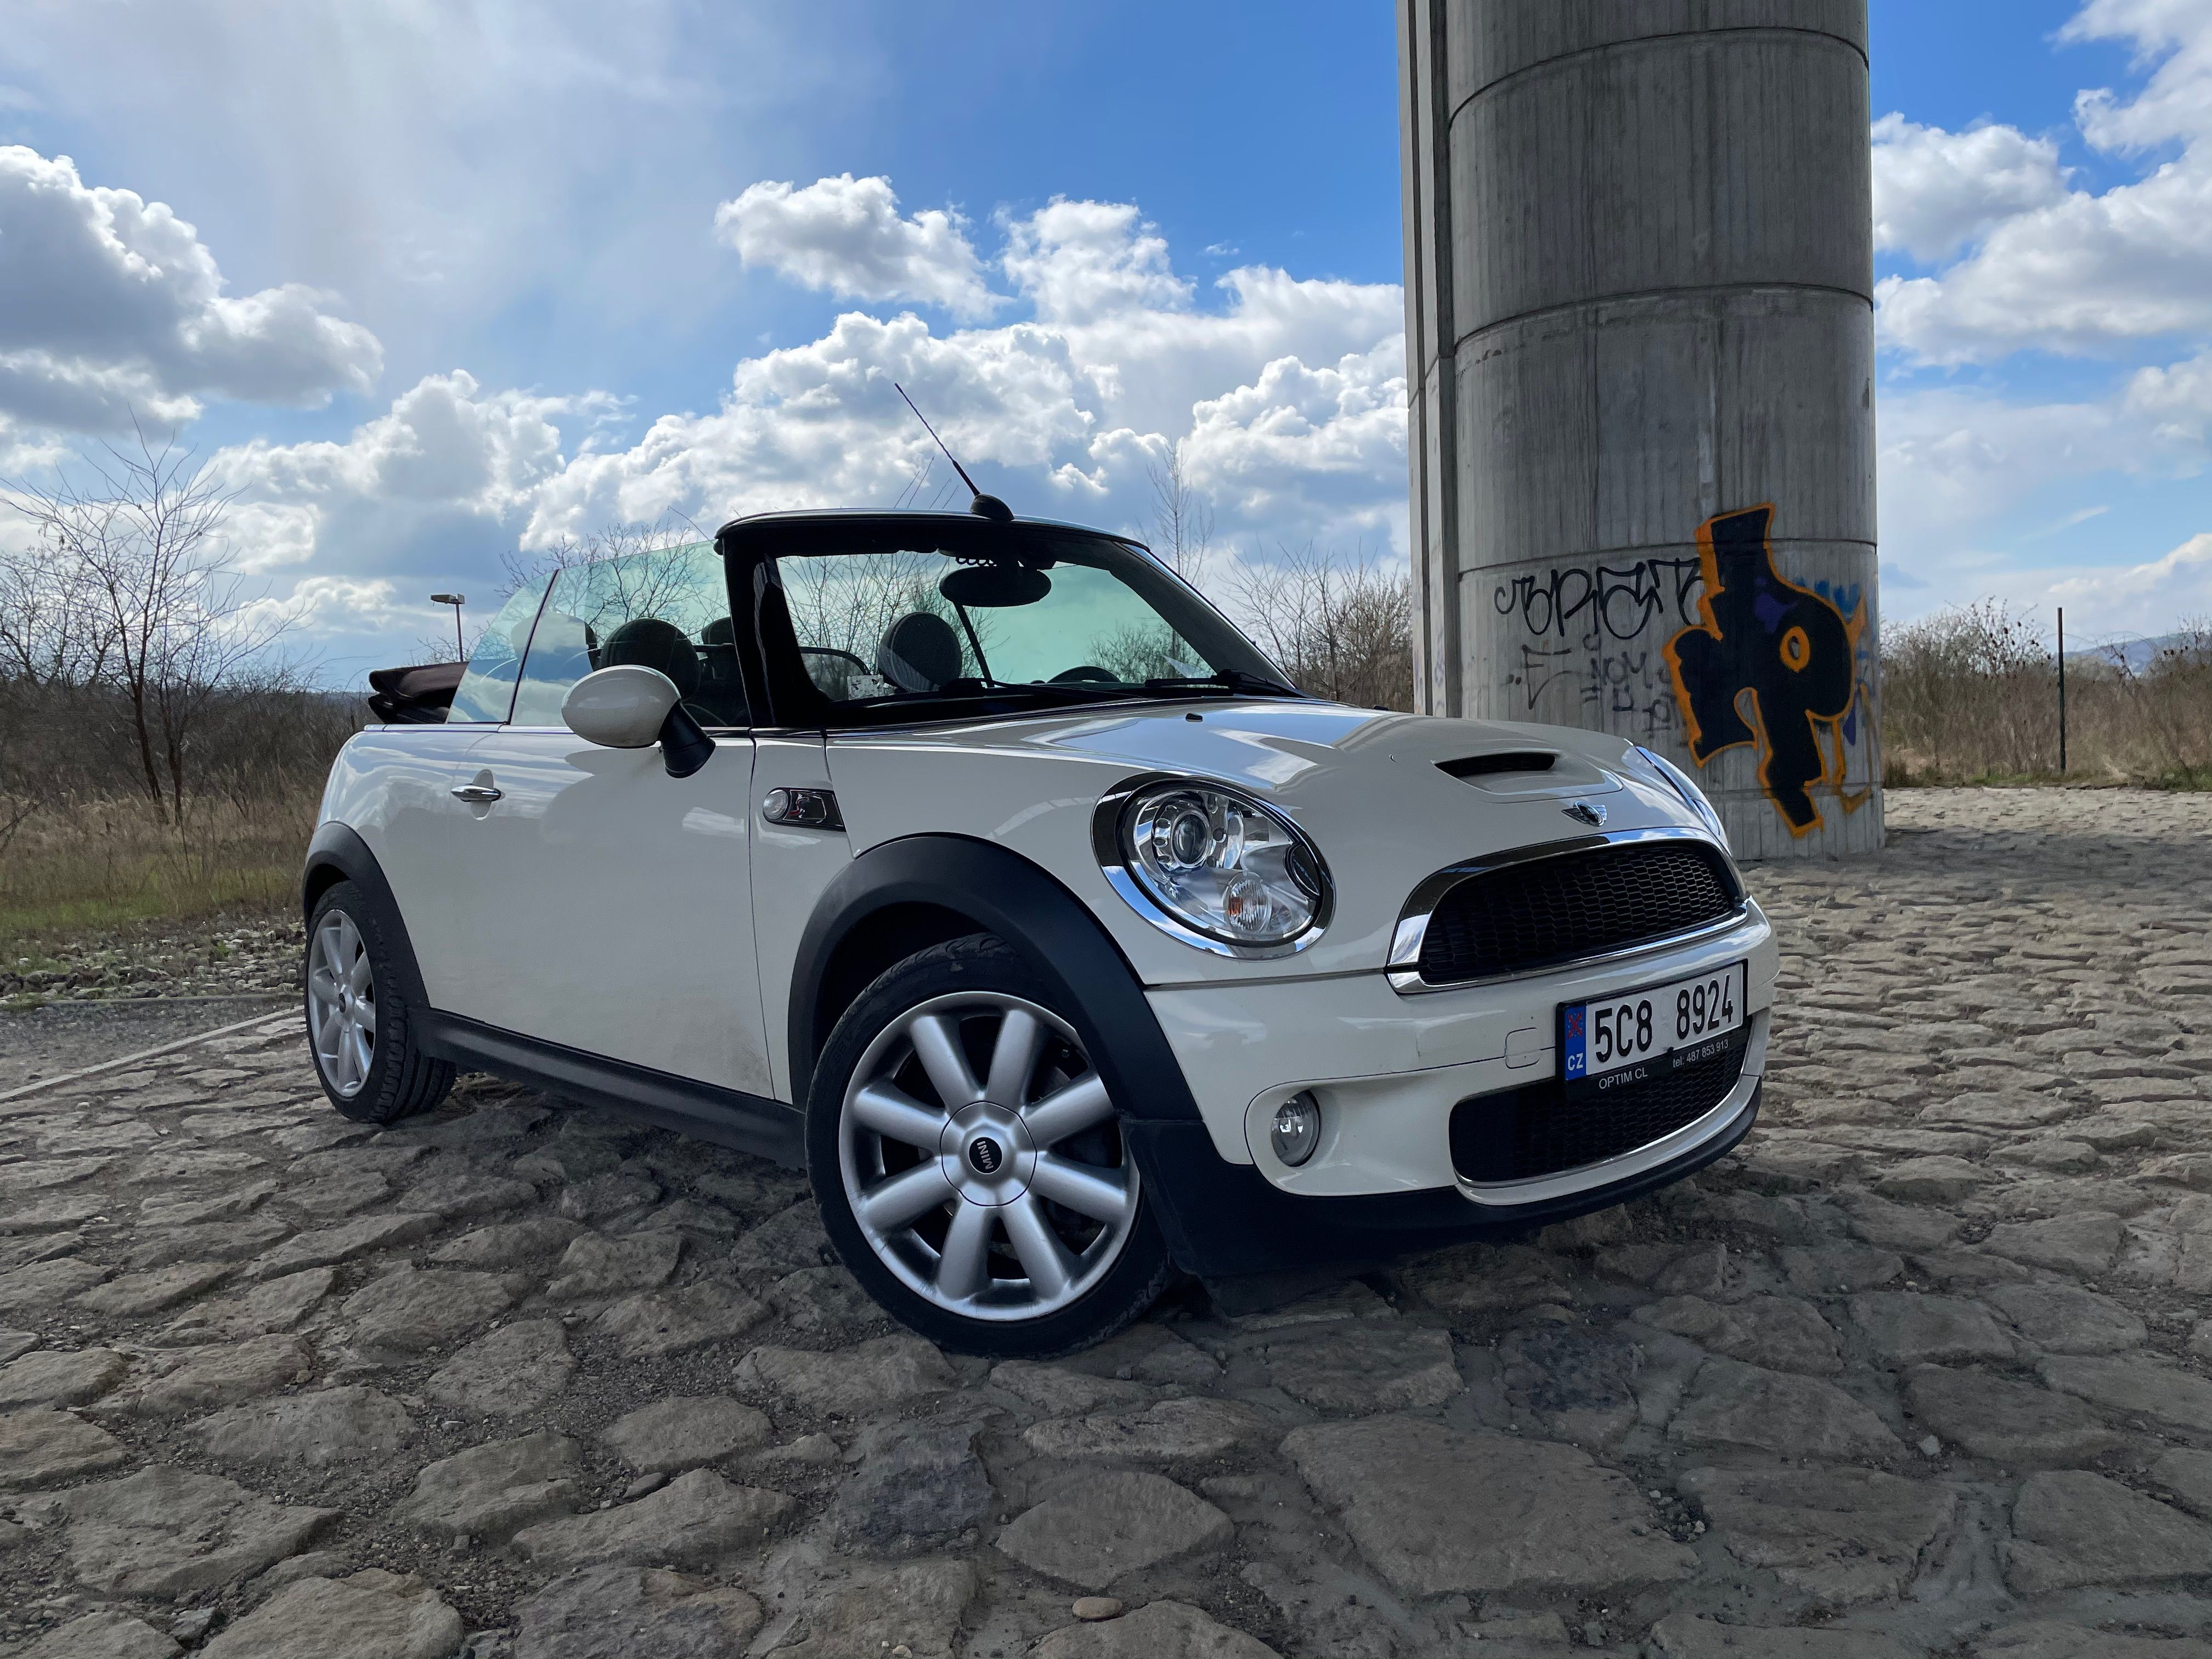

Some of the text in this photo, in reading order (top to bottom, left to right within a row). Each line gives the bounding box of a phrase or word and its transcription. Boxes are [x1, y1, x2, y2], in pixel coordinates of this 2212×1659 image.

[1594, 973, 1734, 1063] 5C8 8924
[1567, 1052, 1583, 1071] CZ
[1673, 1039, 1729, 1068] tel: 487 853 913
[1599, 1066, 1648, 1090] OPTIM CL
[977, 1141, 994, 1170] MINI
